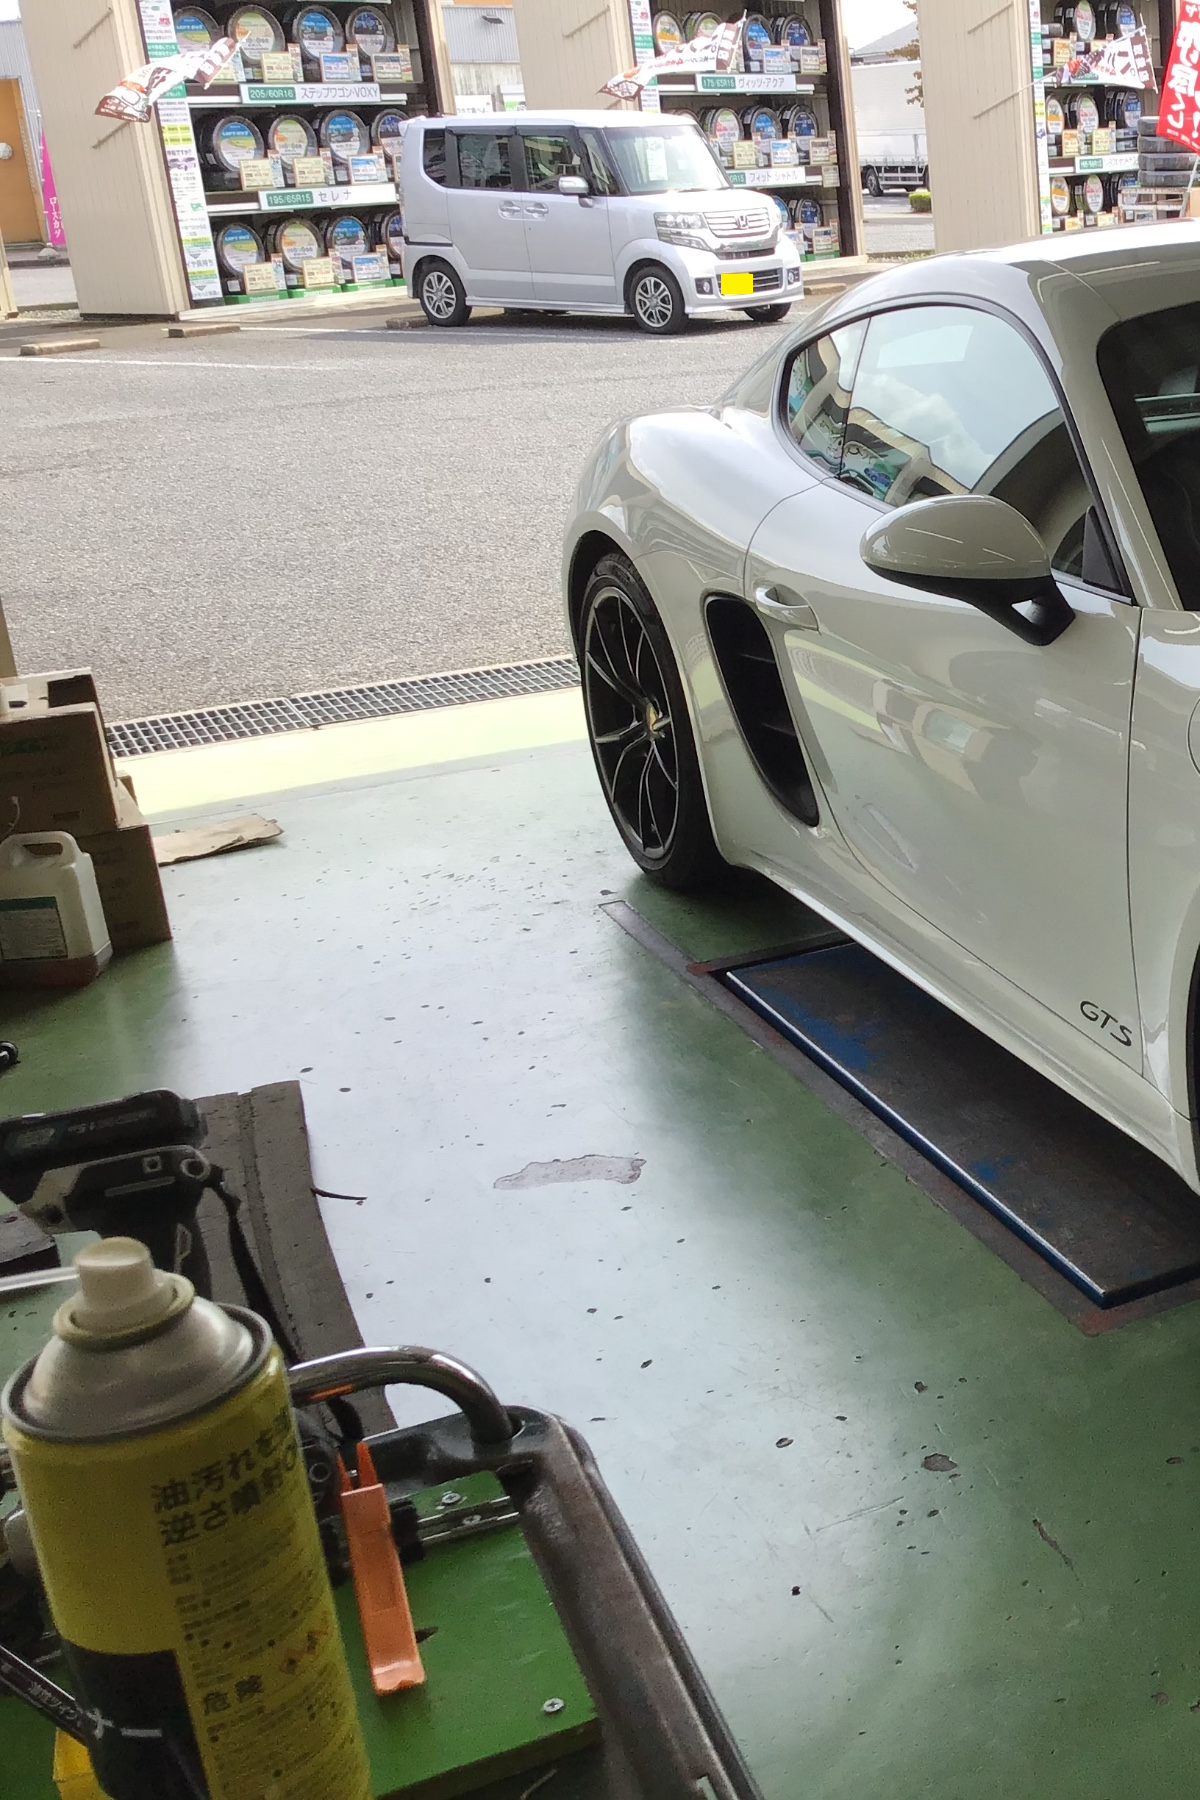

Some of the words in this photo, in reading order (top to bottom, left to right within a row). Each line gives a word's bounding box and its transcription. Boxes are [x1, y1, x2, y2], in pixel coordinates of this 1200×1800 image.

[250, 88, 294, 99] 205/60R16
[267, 192, 313, 205] 195/65R15
[317, 190, 353, 203] セレナ
[49, 197, 61, 238] ロースカツ
[1080, 1000, 1133, 1047] GTS
